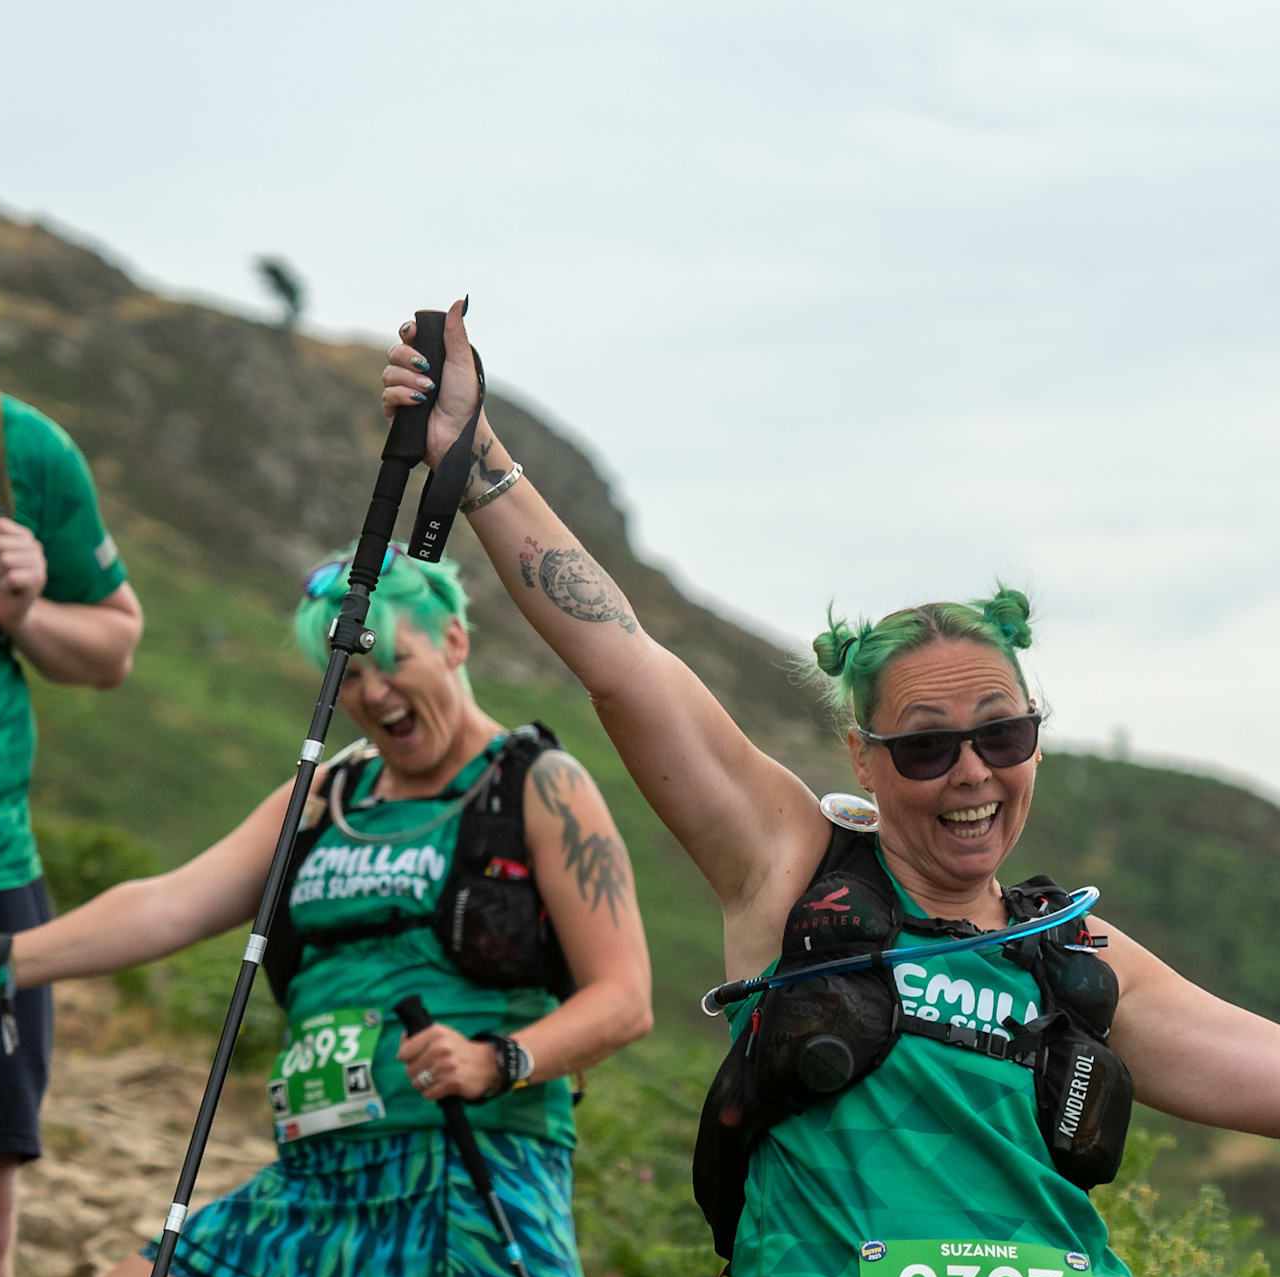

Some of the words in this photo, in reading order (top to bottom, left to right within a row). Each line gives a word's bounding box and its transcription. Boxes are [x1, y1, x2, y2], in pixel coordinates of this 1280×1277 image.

[419, 520, 441, 559] RIER
[793, 914, 861, 933] HARRIER
[1058, 1054, 1095, 1139] KINDER10L
[940, 1243, 1018, 1259] SUZANNE
